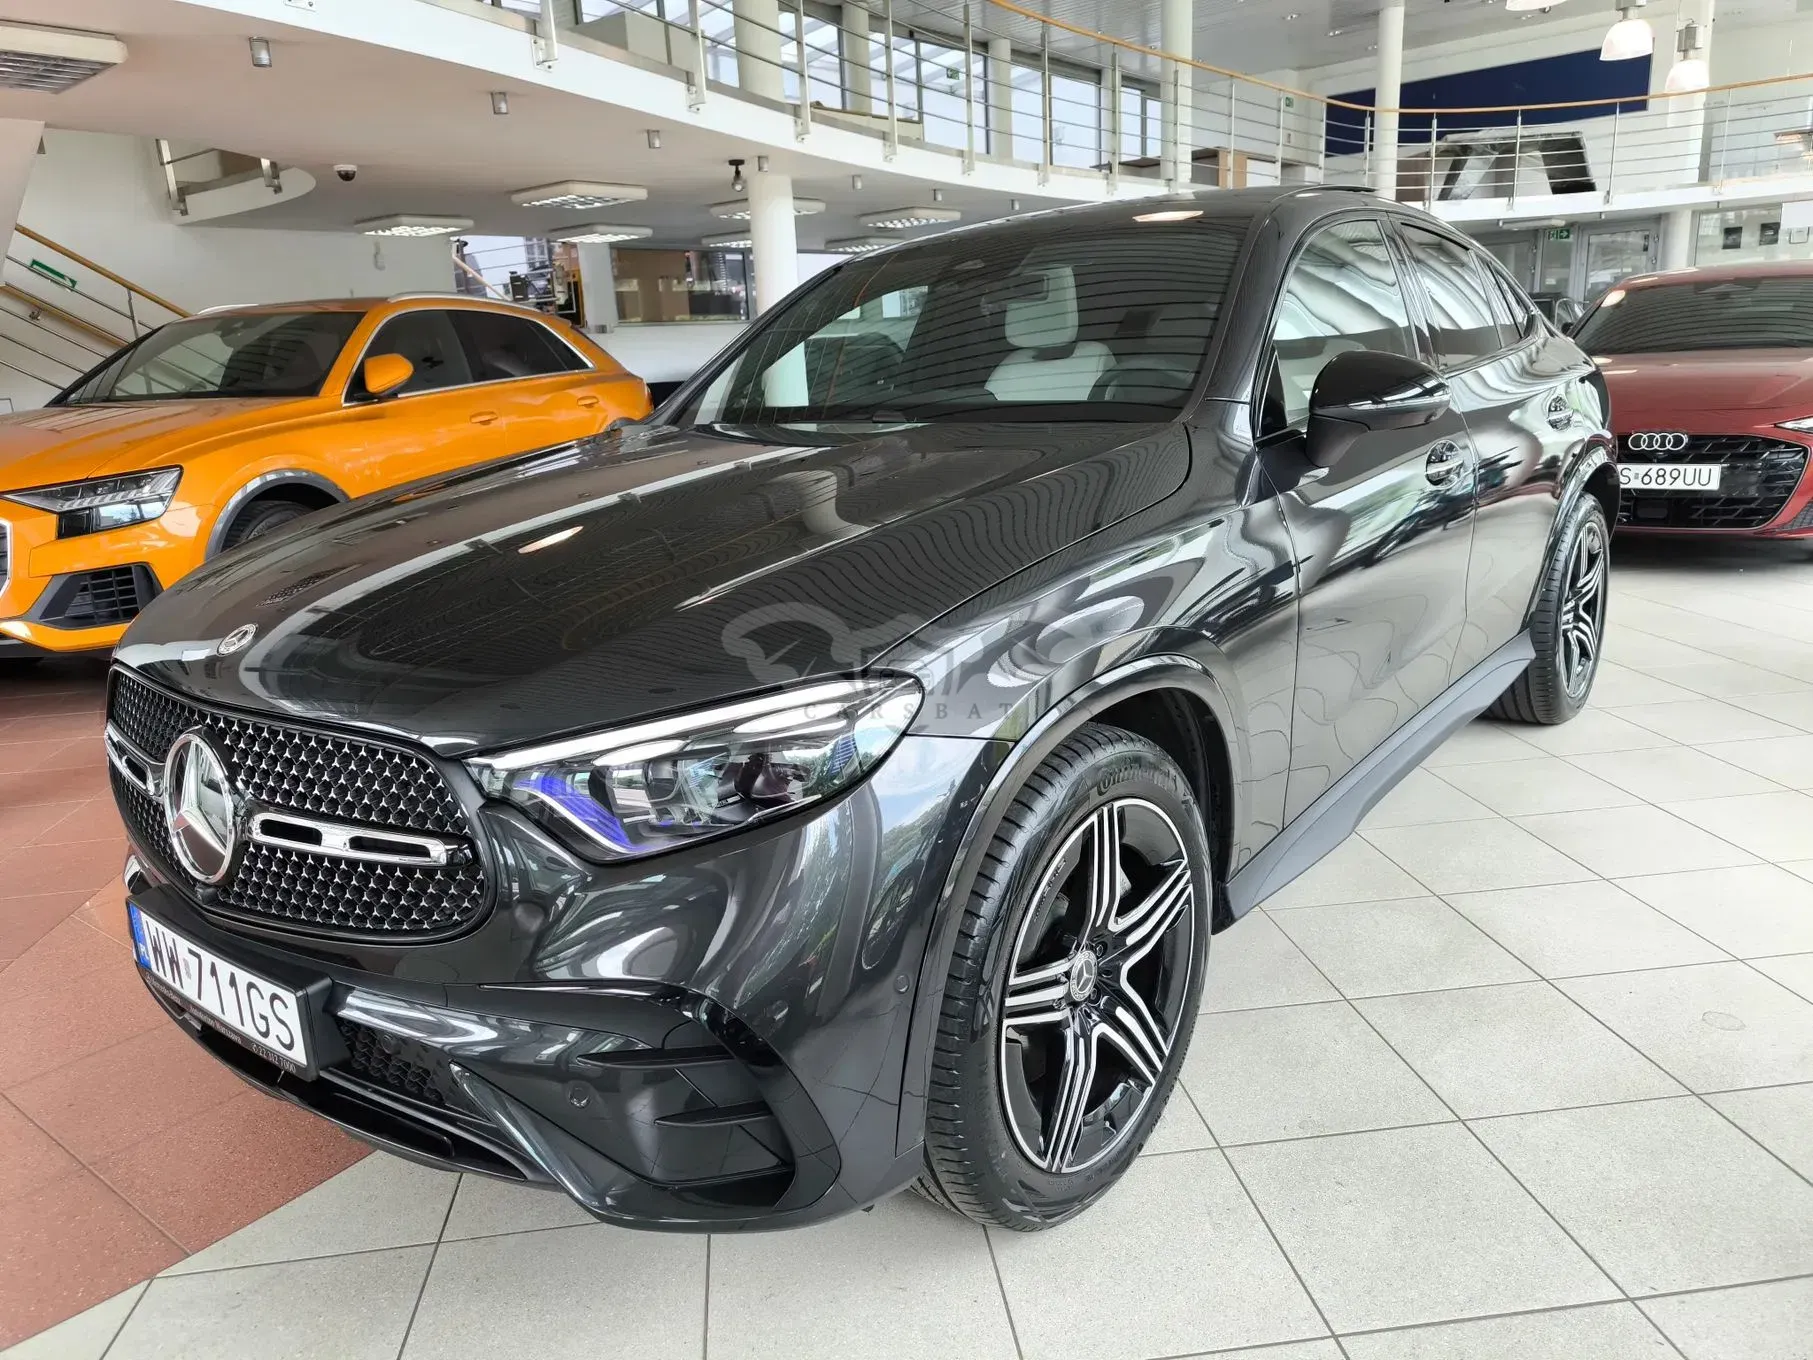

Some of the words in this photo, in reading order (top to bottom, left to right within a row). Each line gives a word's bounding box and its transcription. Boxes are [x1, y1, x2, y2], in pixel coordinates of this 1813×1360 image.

[1641, 467, 1712, 487] 689UU
[145, 919, 184, 990] WW
[187, 948, 295, 1052] 711GS
